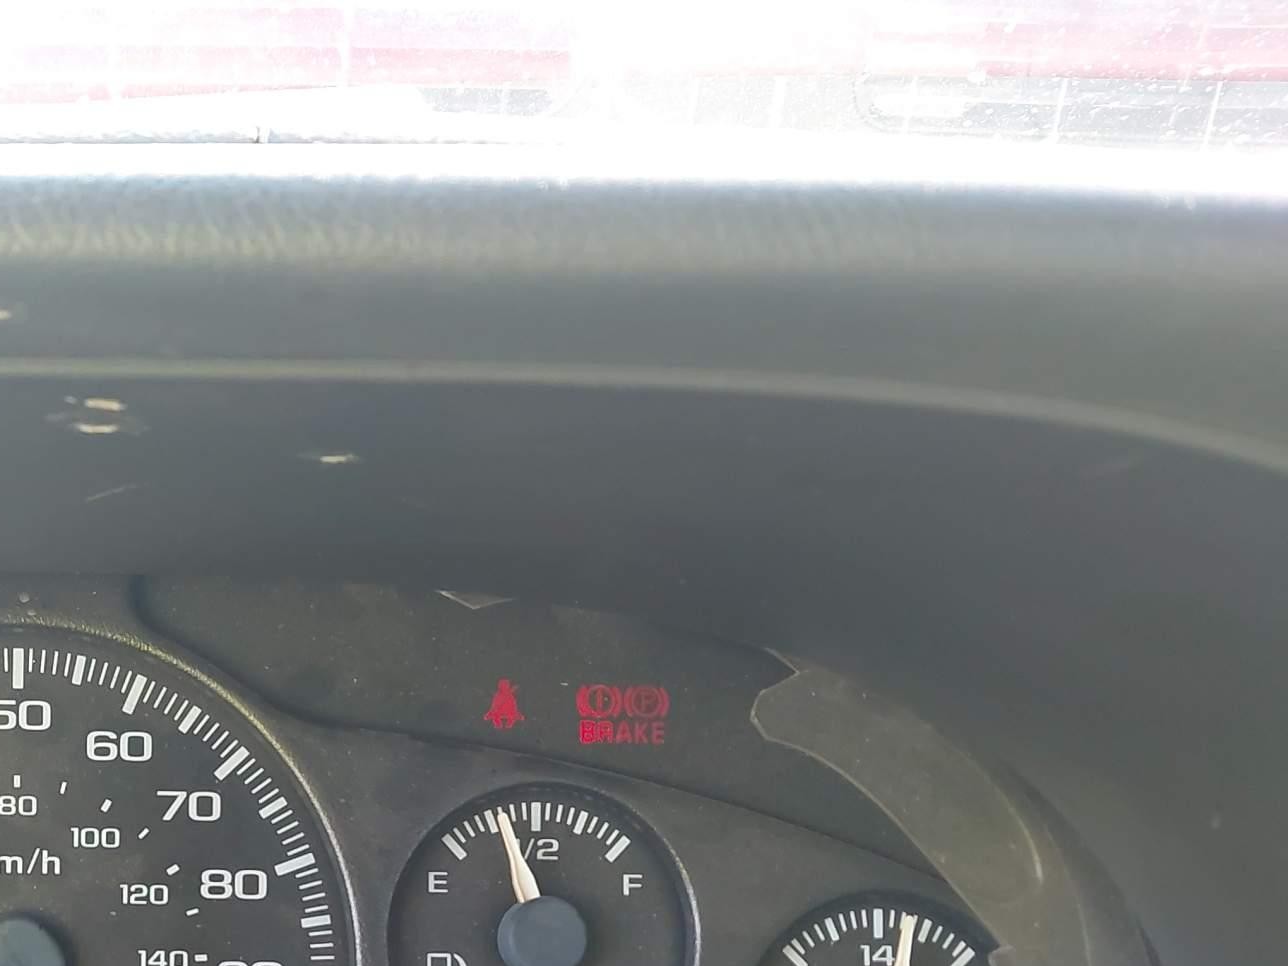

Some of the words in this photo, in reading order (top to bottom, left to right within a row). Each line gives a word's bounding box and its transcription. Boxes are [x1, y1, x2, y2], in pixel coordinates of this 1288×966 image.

[579, 720, 665, 745] BRAKE
[87, 731, 152, 761] 60
[157, 791, 221, 821] 70
[71, 828, 119, 847] 100
[516, 838, 560, 861] /2
[201, 870, 267, 899] 80
[429, 872, 448, 892] E
[623, 874, 642, 895] F
[120, 884, 168, 904] 120
[860, 944, 896, 966] 14
